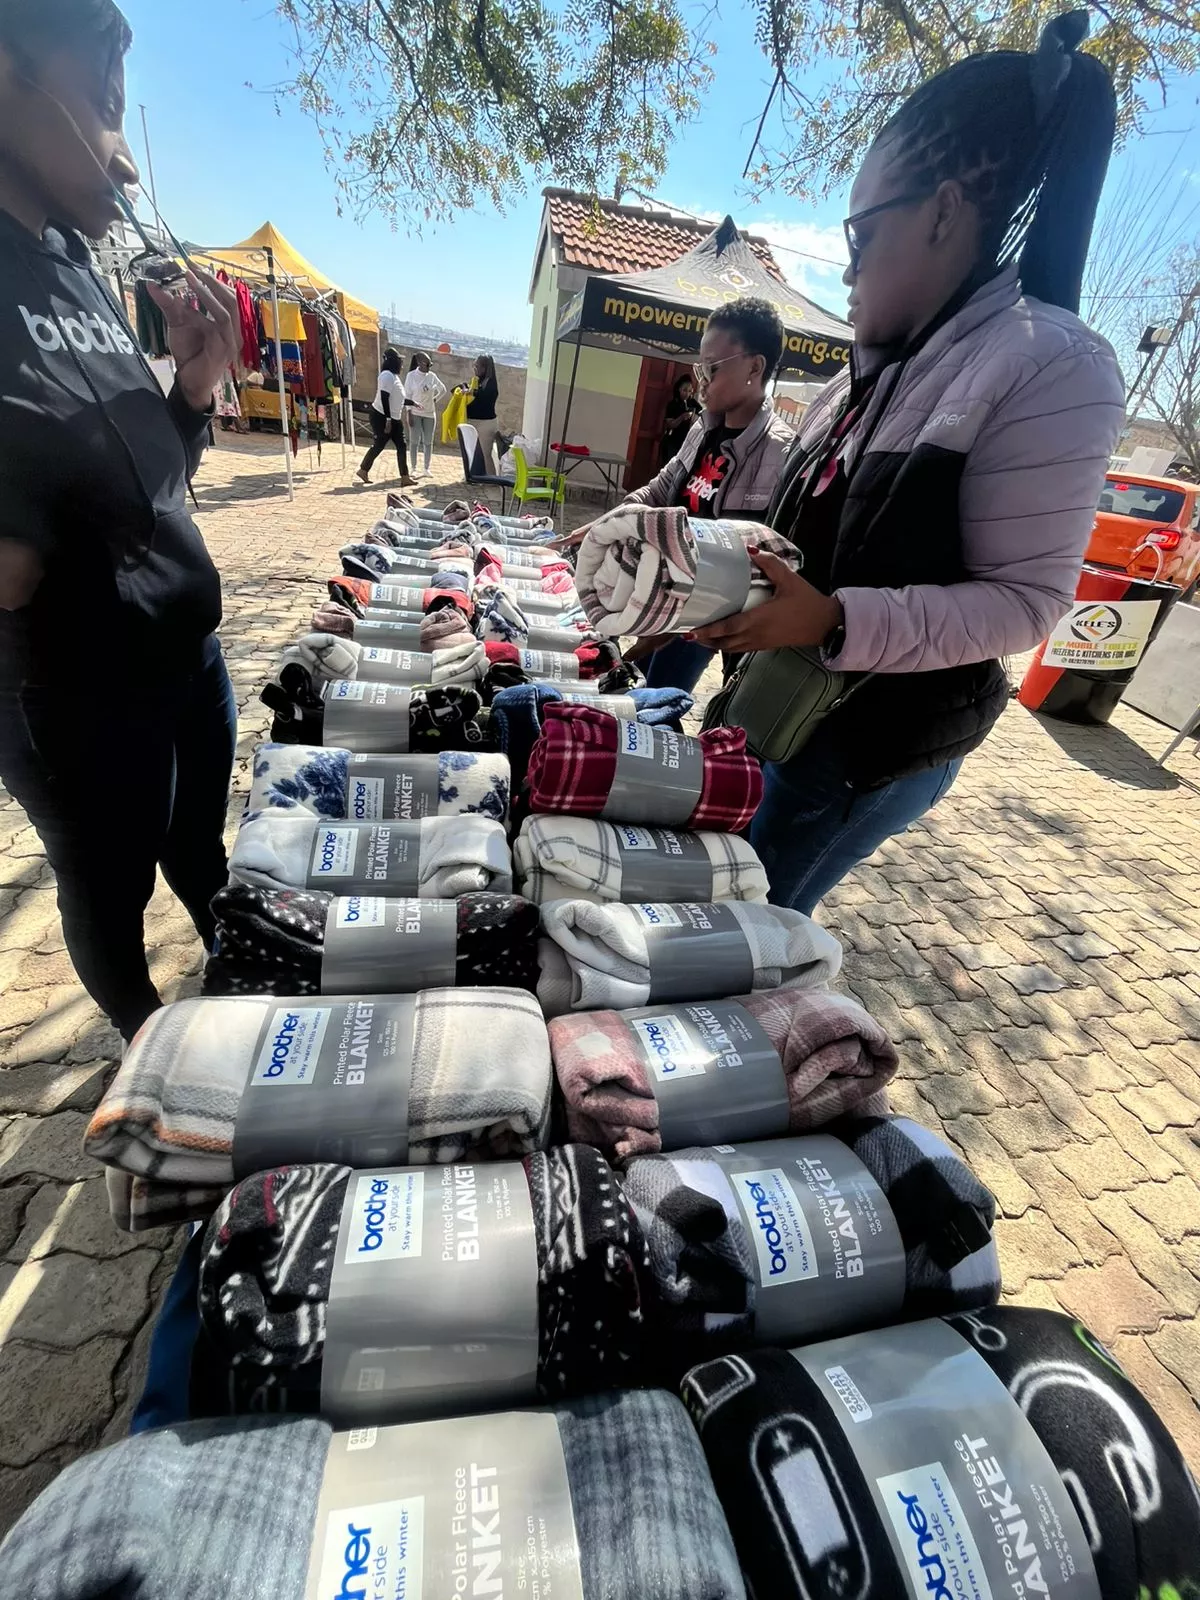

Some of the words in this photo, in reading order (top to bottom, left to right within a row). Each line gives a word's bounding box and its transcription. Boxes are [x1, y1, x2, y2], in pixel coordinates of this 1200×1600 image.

[18, 305, 134, 355] brothe
[687, 475, 719, 501] other
[354, 781, 366, 819] rother
[401, 774, 413, 819] ANKET
[318, 831, 336, 871] brother
[374, 826, 391, 880] BLANKET
[263, 1013, 300, 1078] brother
[293, 1037, 303, 1055] your
[339, 1027, 351, 1049] Polar
[346, 1001, 375, 1085] BLANKET
[643, 1022, 676, 1073] bother
[692, 1006, 743, 1067] BLANKET
[290, 1056, 298, 1065] at
[297, 1063, 308, 1079] Stay
[333, 1051, 347, 1085] Printed
[772, 1174, 787, 1199] winter
[796, 1159, 819, 1192] Fleece
[358, 1179, 389, 1252] brother
[390, 1201, 400, 1221] your
[441, 1188, 453, 1212] Polar
[454, 1165, 480, 1262] BLANKET
[786, 1200, 795, 1218] this
[802, 1157, 864, 1278] BLANKET
[816, 1194, 834, 1227] Polar
[389, 1221, 397, 1232] at
[402, 1230, 413, 1251] Stay
[441, 1214, 454, 1261] Printed
[745, 1180, 787, 1275] brother
[778, 1212, 793, 1238] your
[793, 1219, 804, 1247] warm
[785, 1241, 795, 1253] at
[801, 1250, 809, 1272] Stay
[828, 1230, 845, 1279] Printed
[828, 1374, 857, 1413] GREAT
[954, 1439, 992, 1508] Fleece
[1030, 1484, 1041, 1501] cm
[452, 1466, 467, 1536] Fleece
[930, 1476, 956, 1527] winter
[962, 1433, 1052, 1600] ANKET
[1039, 1504, 1050, 1525] 150
[1040, 1485, 1064, 1539] Polyester
[399, 1509, 409, 1560] winter
[471, 1463, 503, 1600] NKET
[527, 1516, 535, 1534] cm
[930, 1512, 951, 1552] side
[334, 1523, 372, 1600] her
[539, 1518, 550, 1578] Polyester
[955, 1532, 969, 1564] this
[989, 1514, 1018, 1575] Polar
[1054, 1541, 1063, 1559] cm
[372, 1545, 387, 1588] side
[395, 1566, 406, 1600] this
[1060, 1561, 1069, 1583] 125
[1066, 1554, 1075, 1575] 100
[968, 1569, 982, 1600] arm
